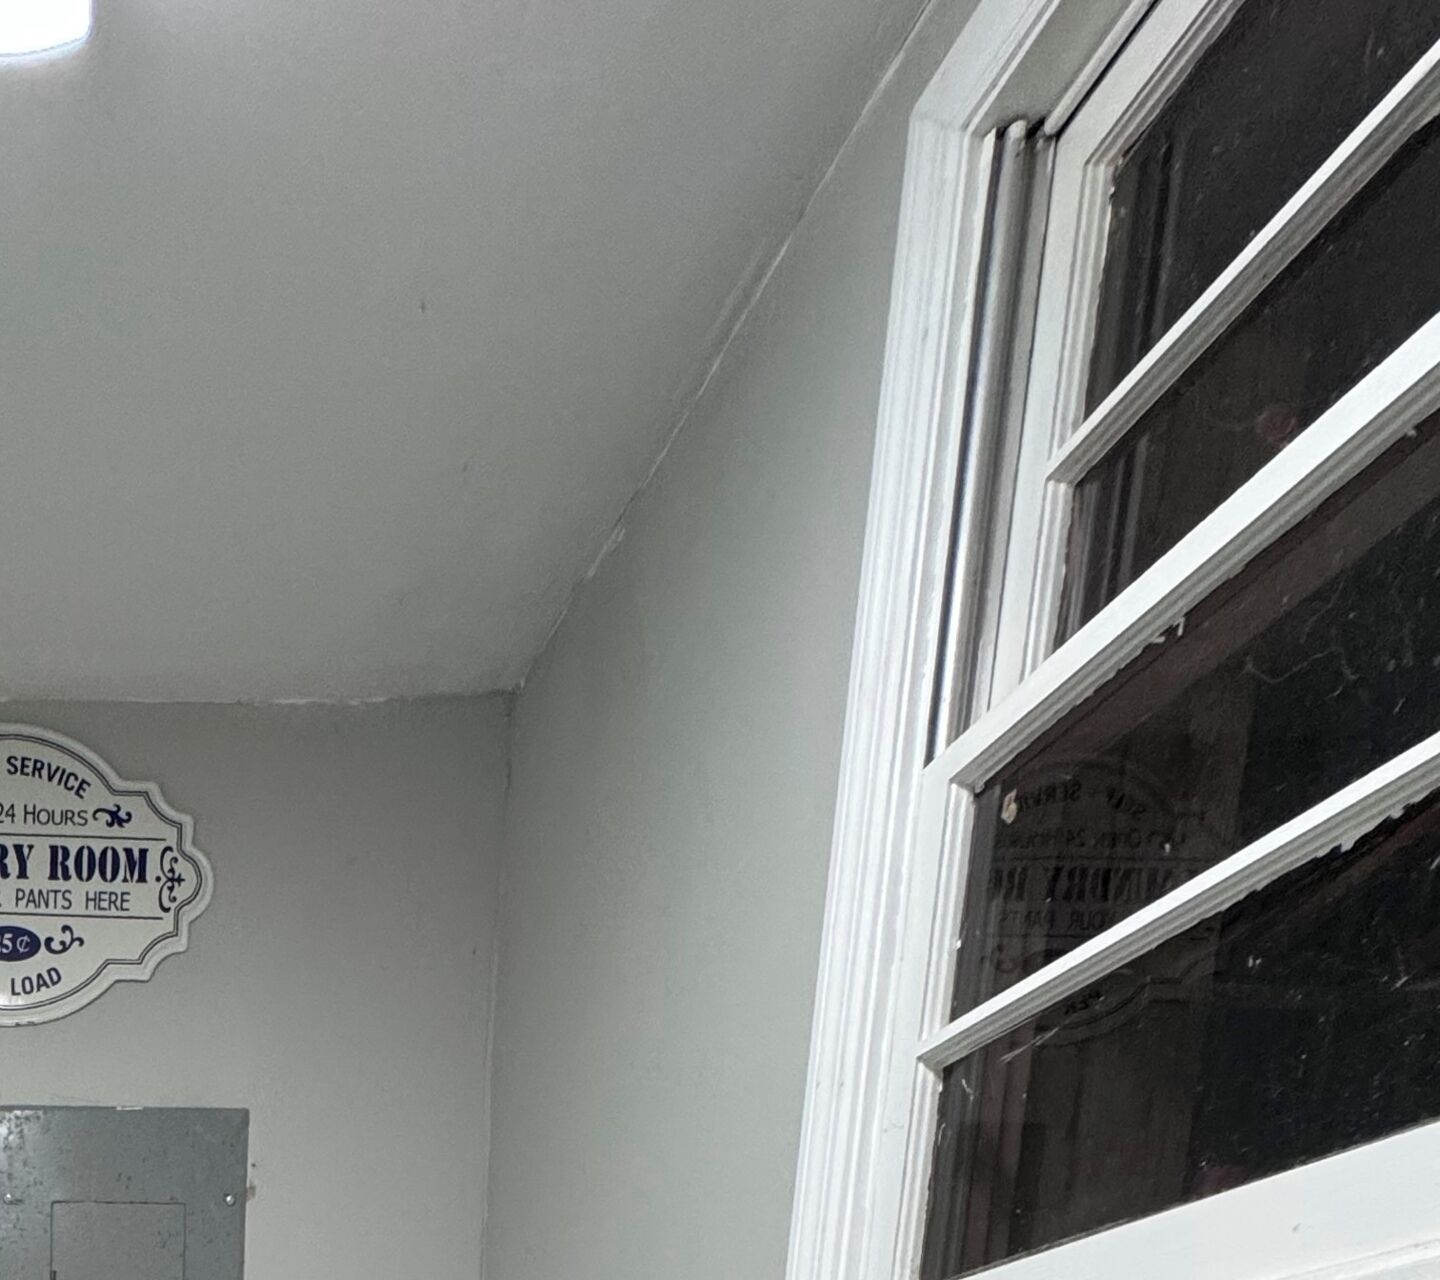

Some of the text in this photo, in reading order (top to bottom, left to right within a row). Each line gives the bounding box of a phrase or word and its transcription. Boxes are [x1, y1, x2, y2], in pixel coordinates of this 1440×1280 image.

[6, 754, 92, 800] SERVICE
[23, 803, 89, 827] HOURS
[47, 844, 149, 884] ROOM
[15, 888, 73, 910] PANTS
[85, 891, 131, 912] HERE
[10, 966, 62, 996] LOAD
